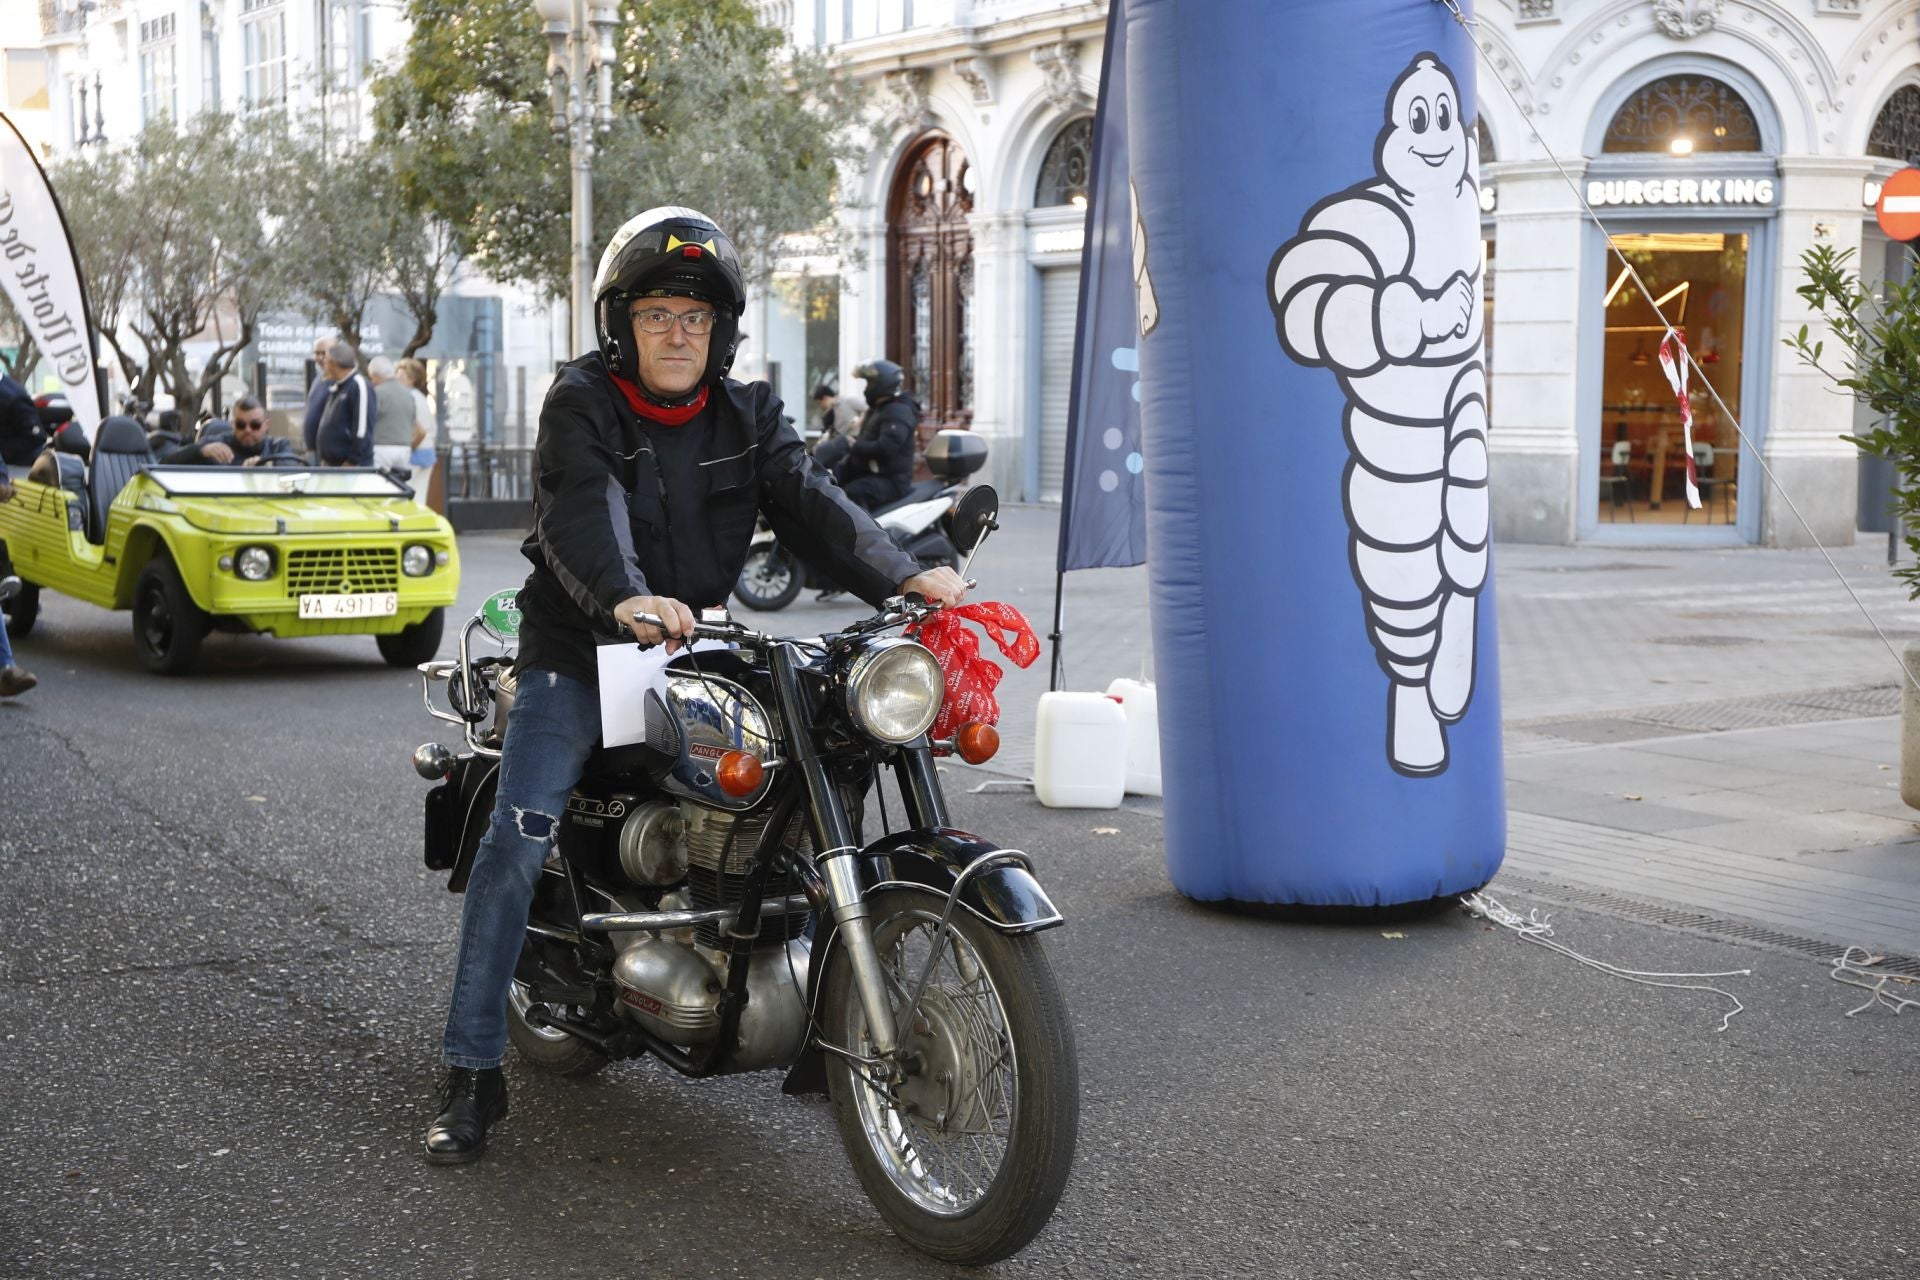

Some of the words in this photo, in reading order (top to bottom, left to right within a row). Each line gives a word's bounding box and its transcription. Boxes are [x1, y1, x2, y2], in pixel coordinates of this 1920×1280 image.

[1587, 179, 1698, 206] BURGER
[1701, 179, 1774, 204] KING
[303, 597, 322, 614] VA
